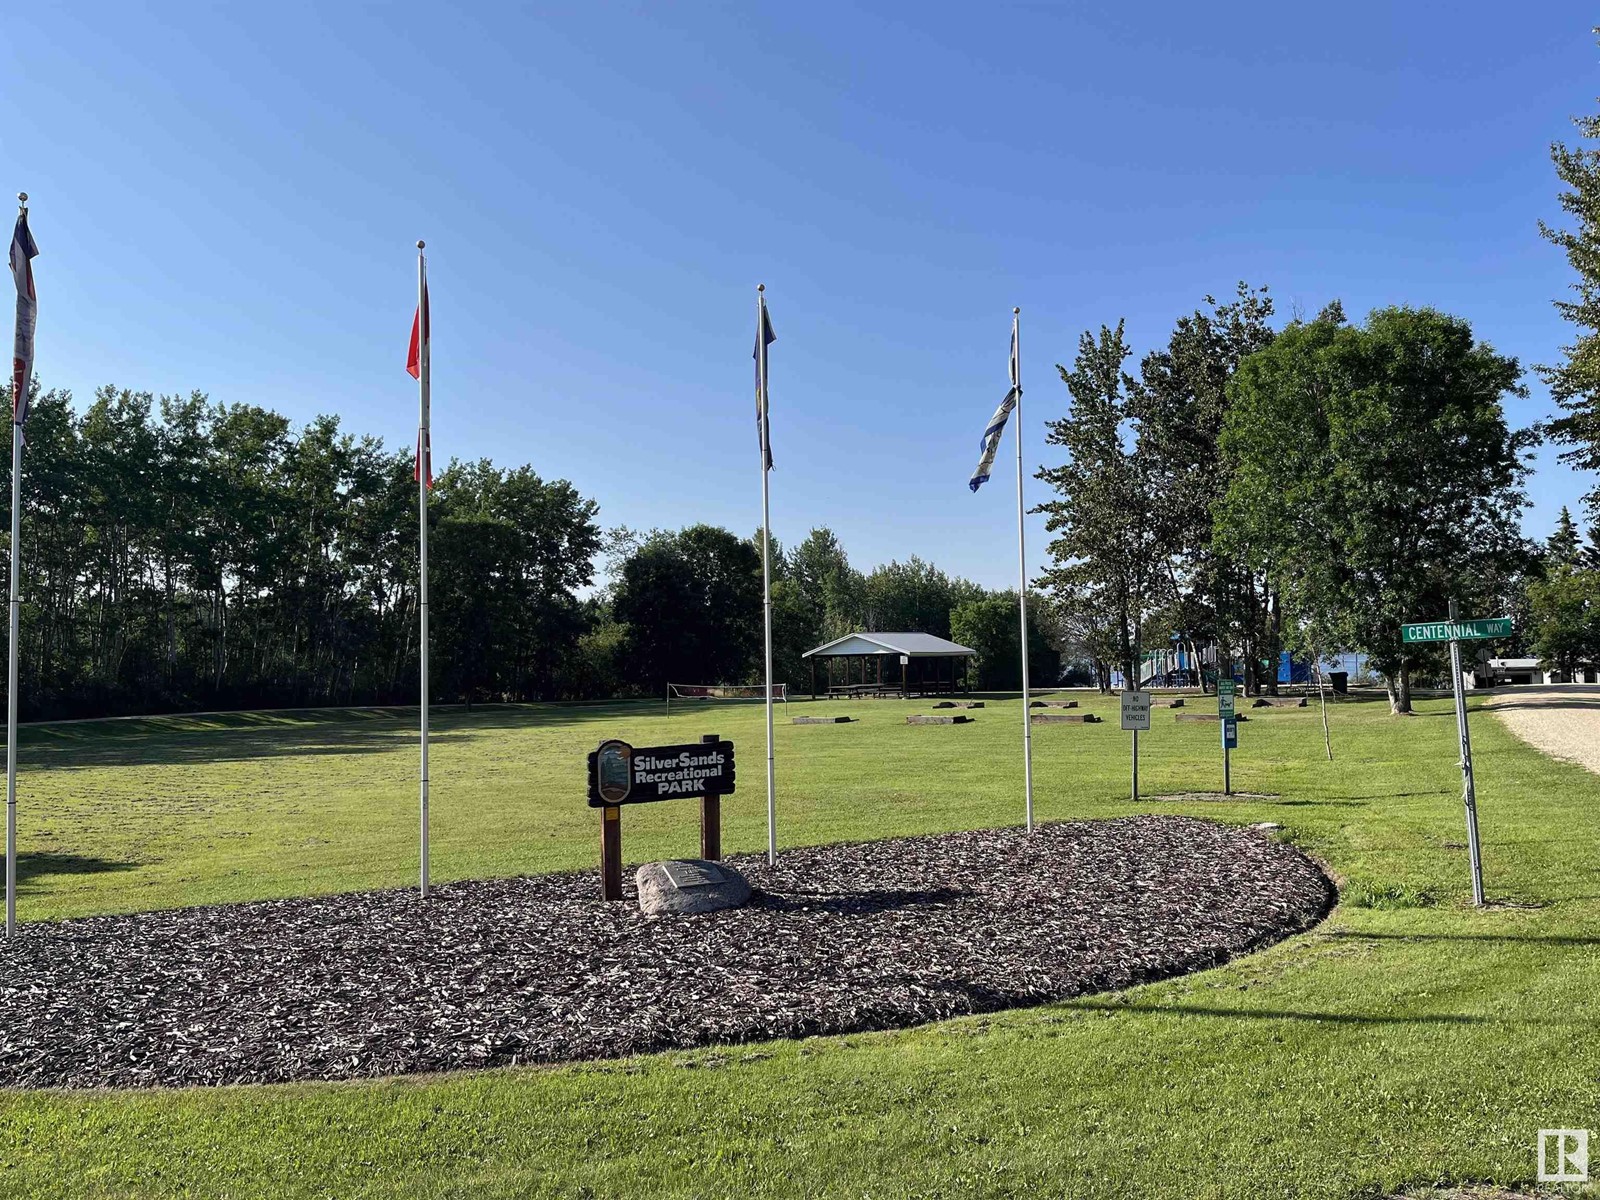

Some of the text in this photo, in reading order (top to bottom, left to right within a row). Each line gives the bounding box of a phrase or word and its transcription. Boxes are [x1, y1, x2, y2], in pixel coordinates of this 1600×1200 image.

[1408, 622, 1504, 640] CENTENNIAL WAY
[635, 765, 722, 784] Recreational
[657, 779, 705, 795] PARK
